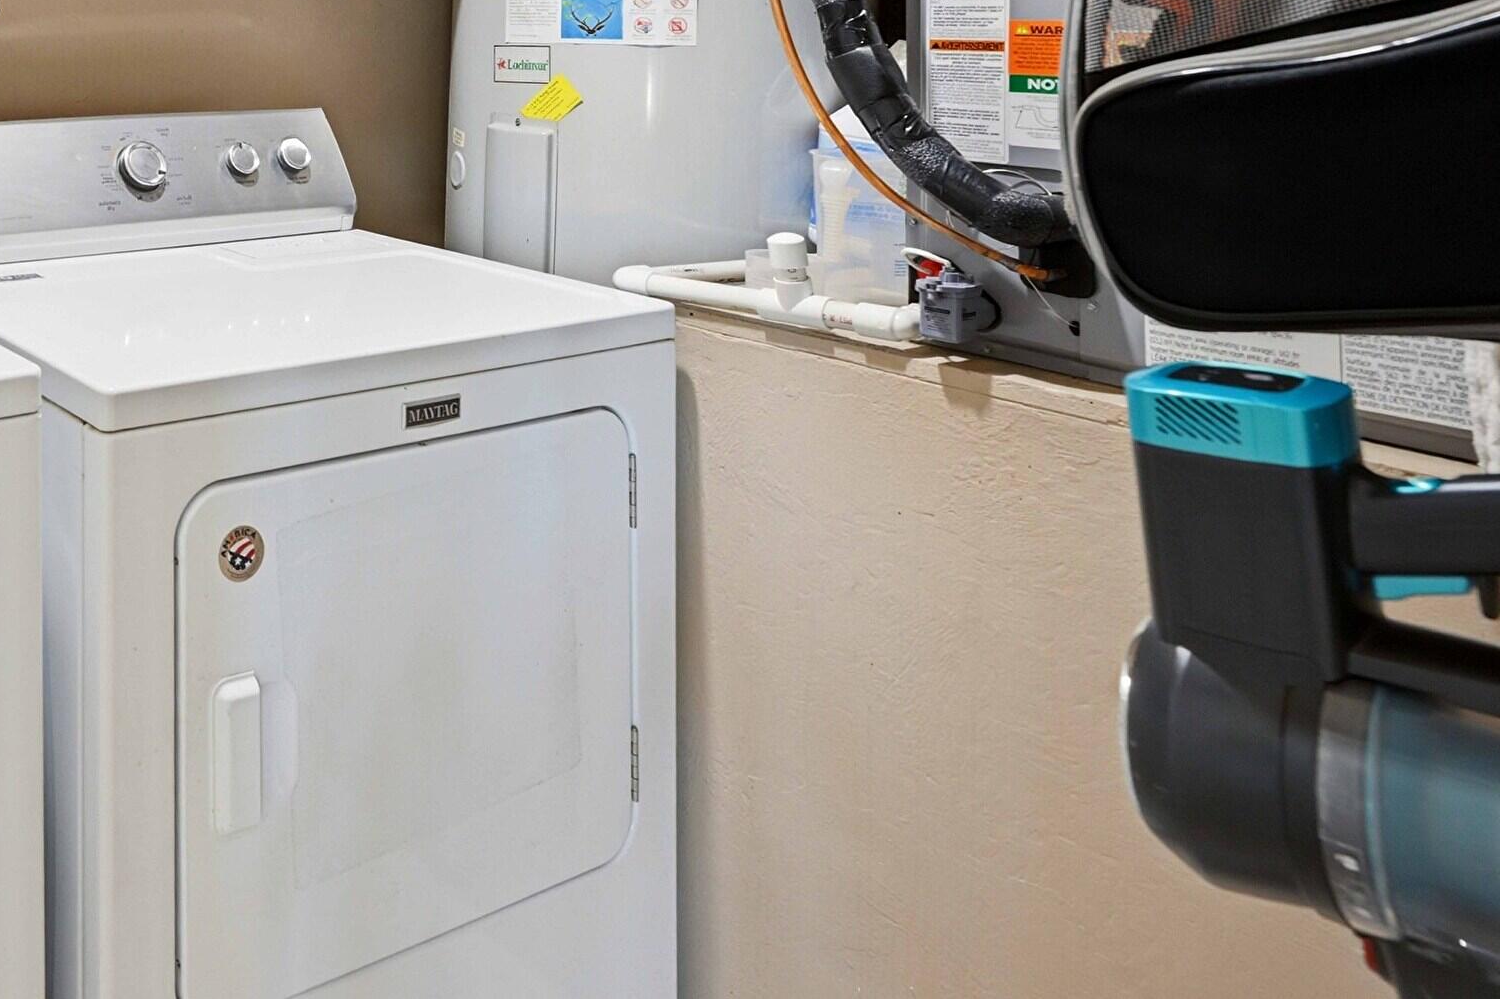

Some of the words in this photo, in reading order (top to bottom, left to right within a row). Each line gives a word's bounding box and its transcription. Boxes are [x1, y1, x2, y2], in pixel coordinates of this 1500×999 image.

[508, 59, 548, 71] Lochinvar
[409, 402, 458, 422] MAYTAG
[221, 528, 257, 558] AMERICA
